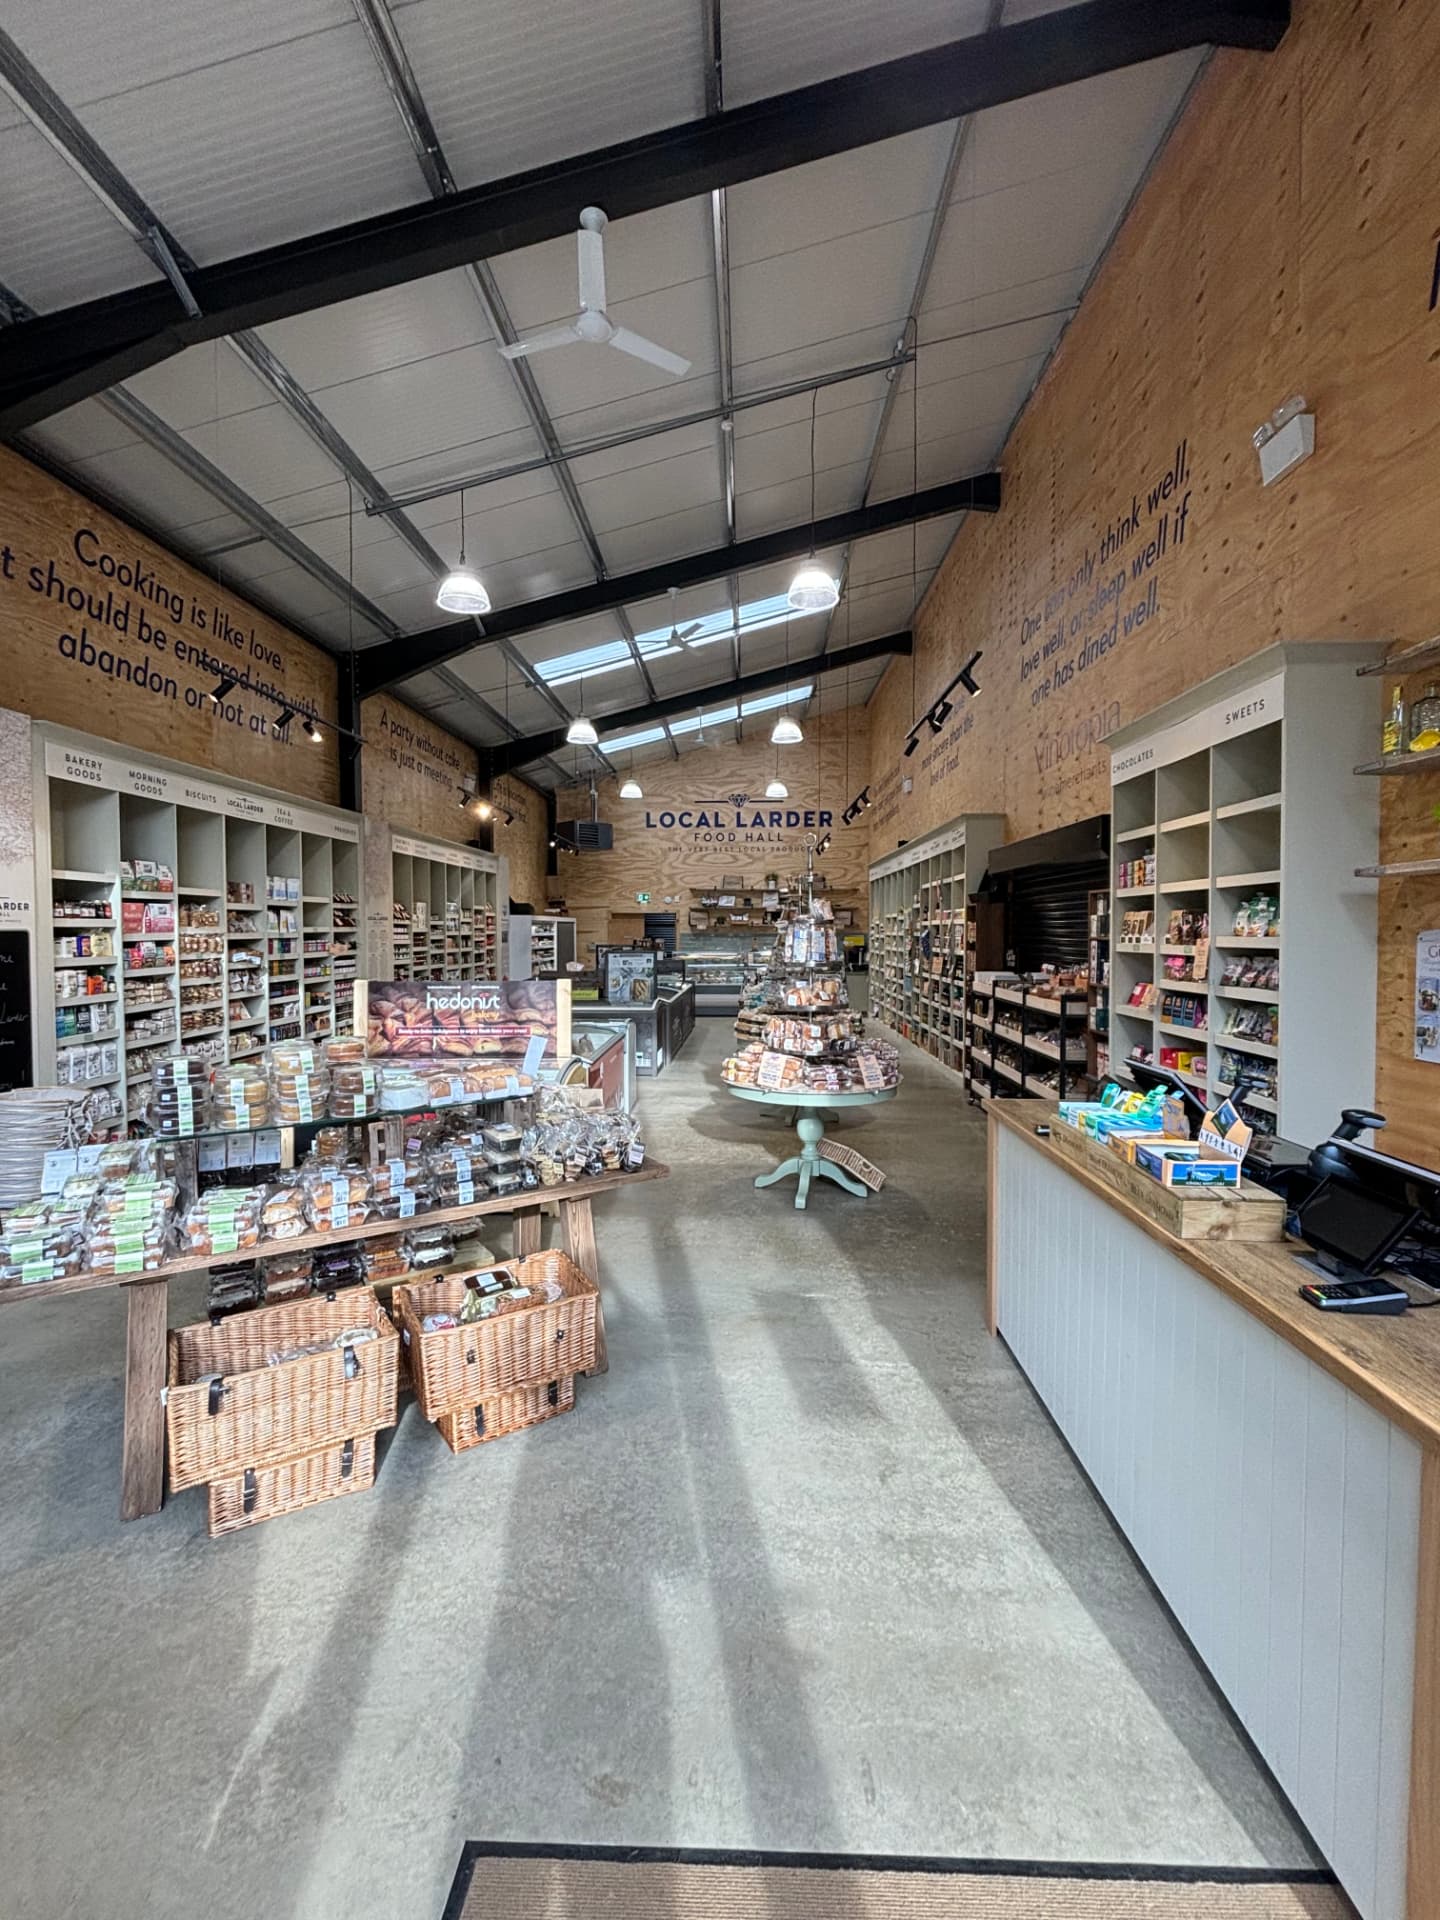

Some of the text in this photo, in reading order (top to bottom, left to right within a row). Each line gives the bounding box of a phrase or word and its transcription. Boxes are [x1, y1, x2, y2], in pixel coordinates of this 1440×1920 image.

[1020, 613, 1042, 645] One
[1068, 547, 1097, 598] only
[1100, 495, 1142, 565] think
[1147, 438, 1190, 516] well,
[1020, 651, 1040, 682] love
[1070, 609, 1083, 637] or
[1087, 568, 1126, 622] sleep
[1132, 513, 1168, 580] well
[1173, 490, 1192, 544] if
[74, 528, 286, 673] Cooking is like love.
[28, 560, 130, 633] should
[137, 609, 167, 650] be
[174, 638, 250, 690] entered
[255, 672, 287, 707] into
[290, 693, 319, 722] with
[1031, 575, 1160, 707] one has dined well.
[58, 628, 294, 746] abandon or not at all.
[1225, 698, 1266, 725] SWEETS
[380, 708, 388, 729] A
[390, 720, 415, 748] party
[416, 734, 444, 761] without
[65, 753, 103, 770] BAKERY
[390, 744, 397, 761] is
[398, 746, 415, 770] just
[417, 761, 423, 774] a
[1112, 748, 1154, 774] CHOCOLATES
[66, 766, 102, 782] GOODS
[128, 770, 168, 787] MORNING
[134, 782, 163, 796] GOODS
[185, 788, 217, 803] BISCUITS
[226, 799, 243, 809] LOCAL
[244, 803, 264, 813] LARDER
[277, 807, 286, 815] TEA
[274, 815, 294, 825] COFFEE
[645, 810, 833, 829] LOCAL LARDER
[694, 832, 784, 842] FOOD HALL
[426, 992, 501, 1010] hedonist
